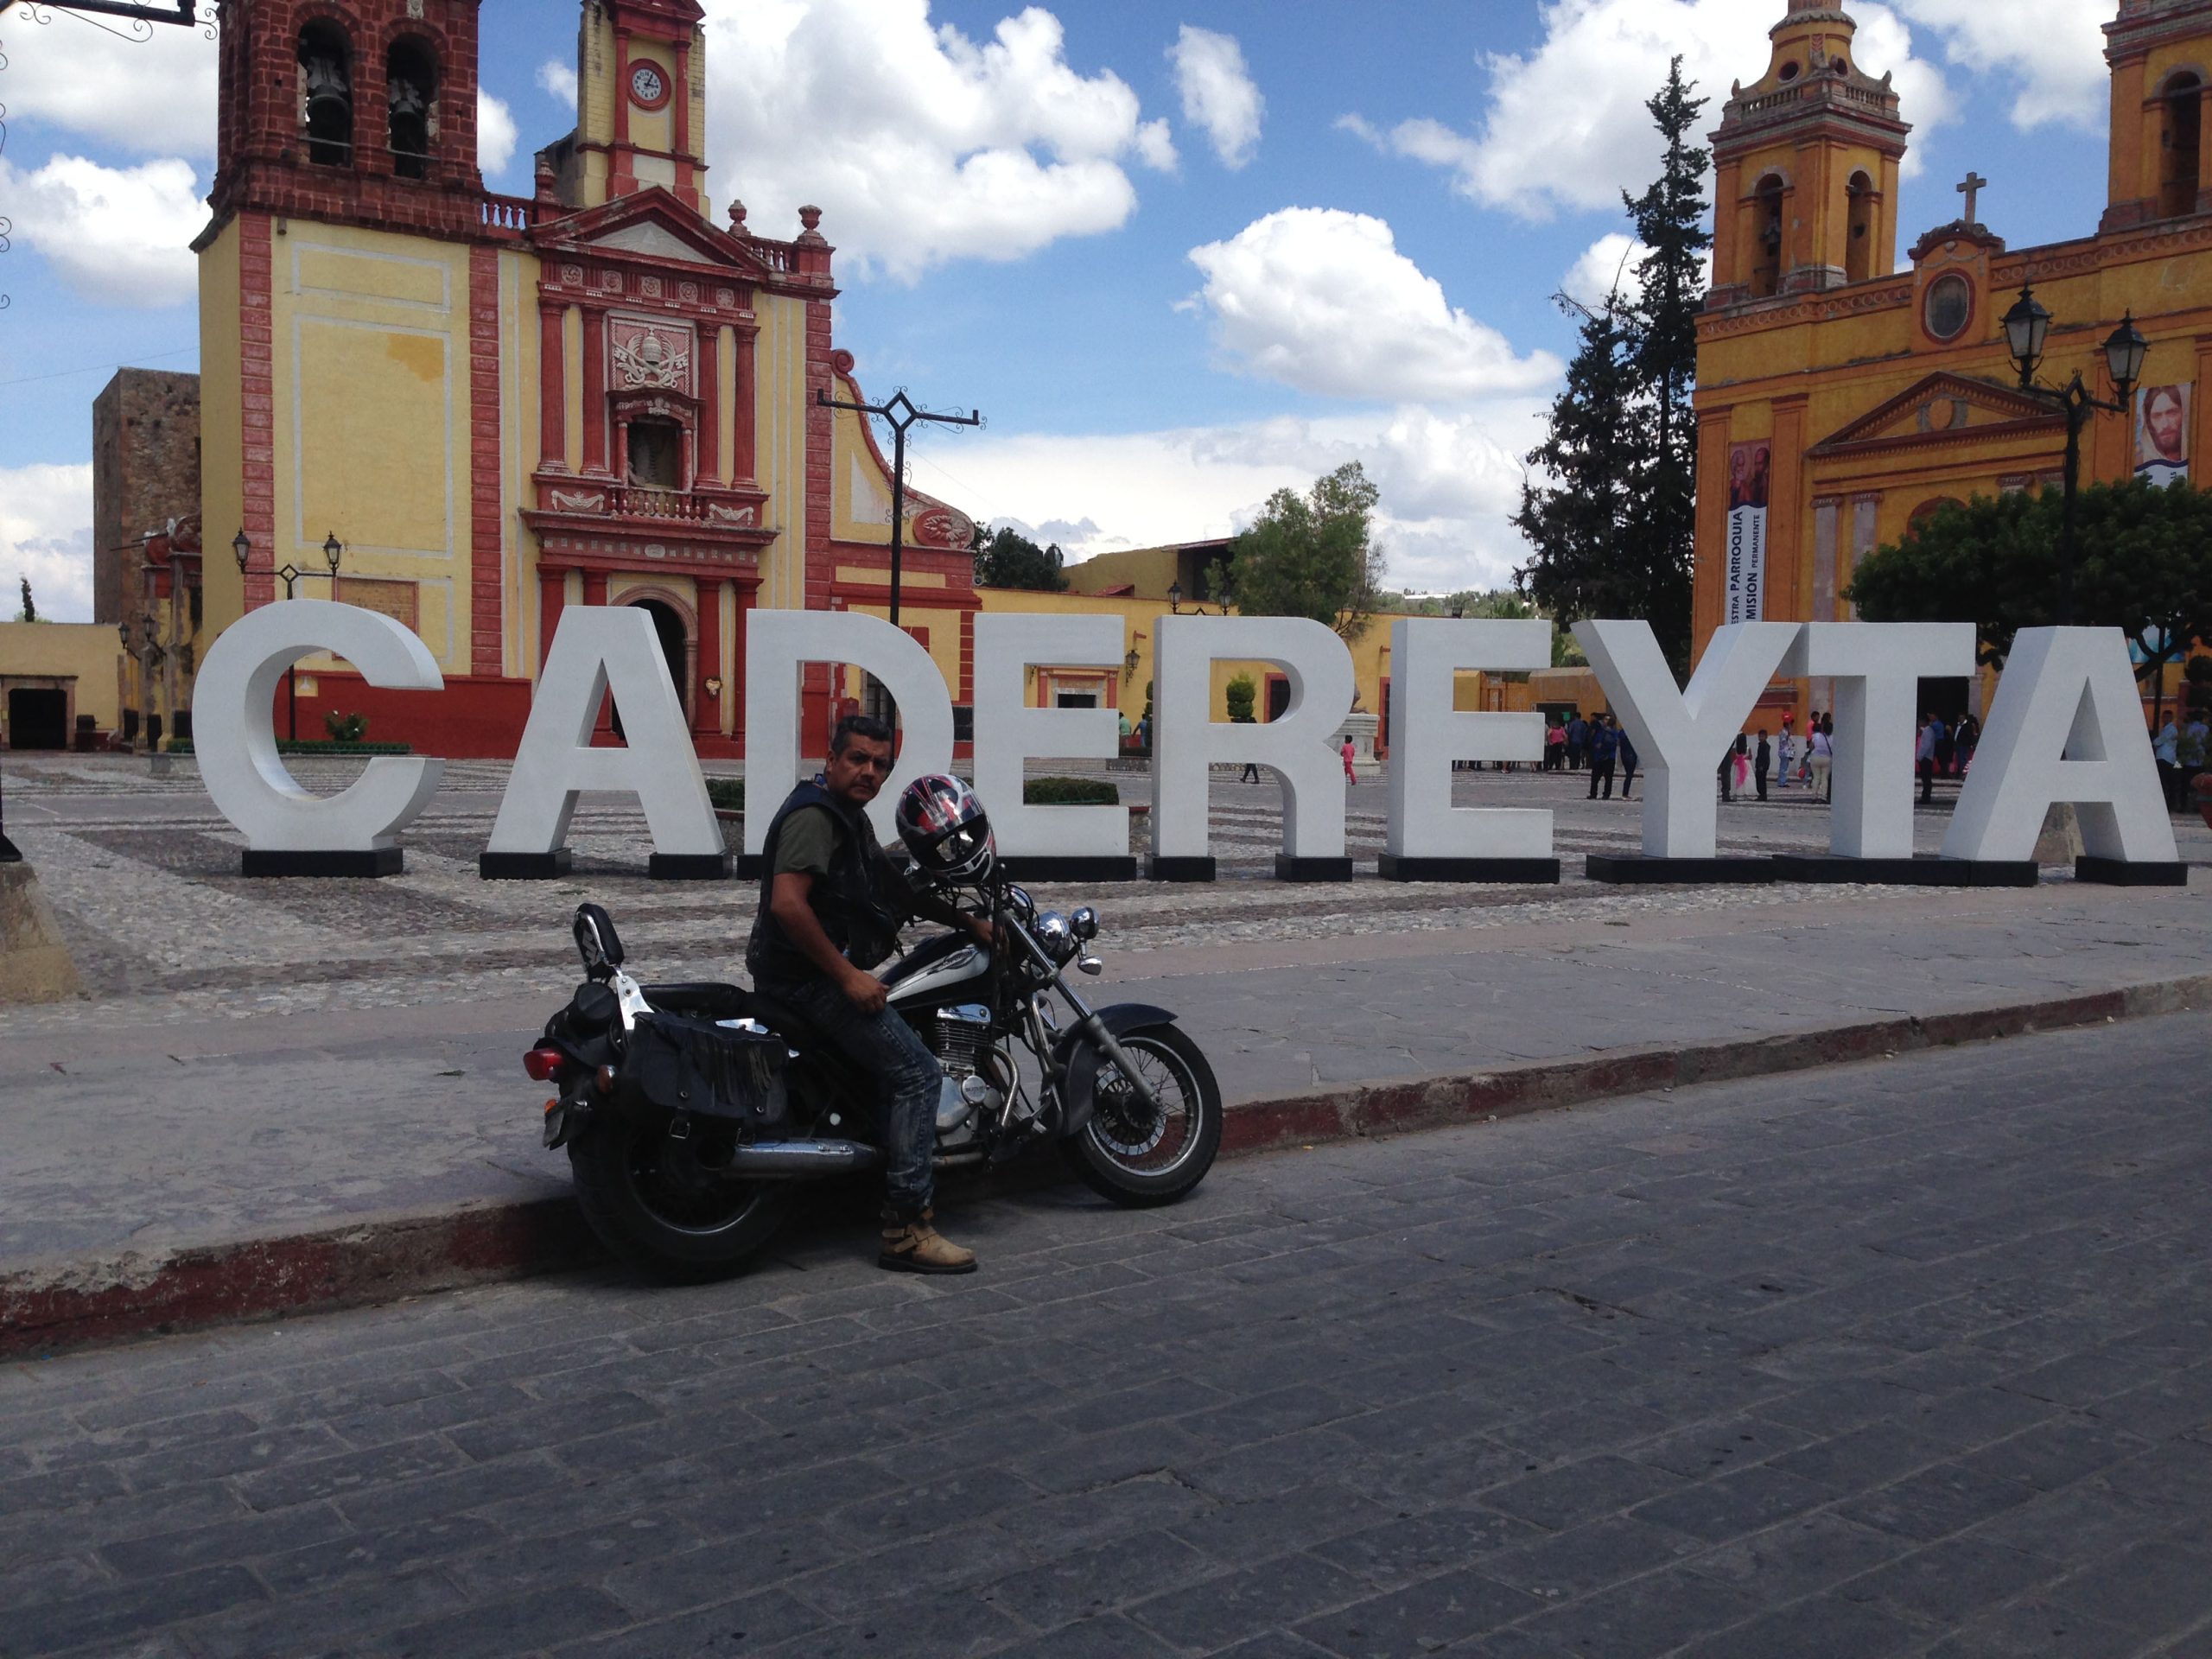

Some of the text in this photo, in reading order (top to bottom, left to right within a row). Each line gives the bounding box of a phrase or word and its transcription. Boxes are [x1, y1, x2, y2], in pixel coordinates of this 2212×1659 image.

[1730, 512, 1743, 591] PARROQUIA
[1745, 514, 1760, 620] MISIÓN PERMANENTE
[192, 599, 2179, 862] CADEREYTA
